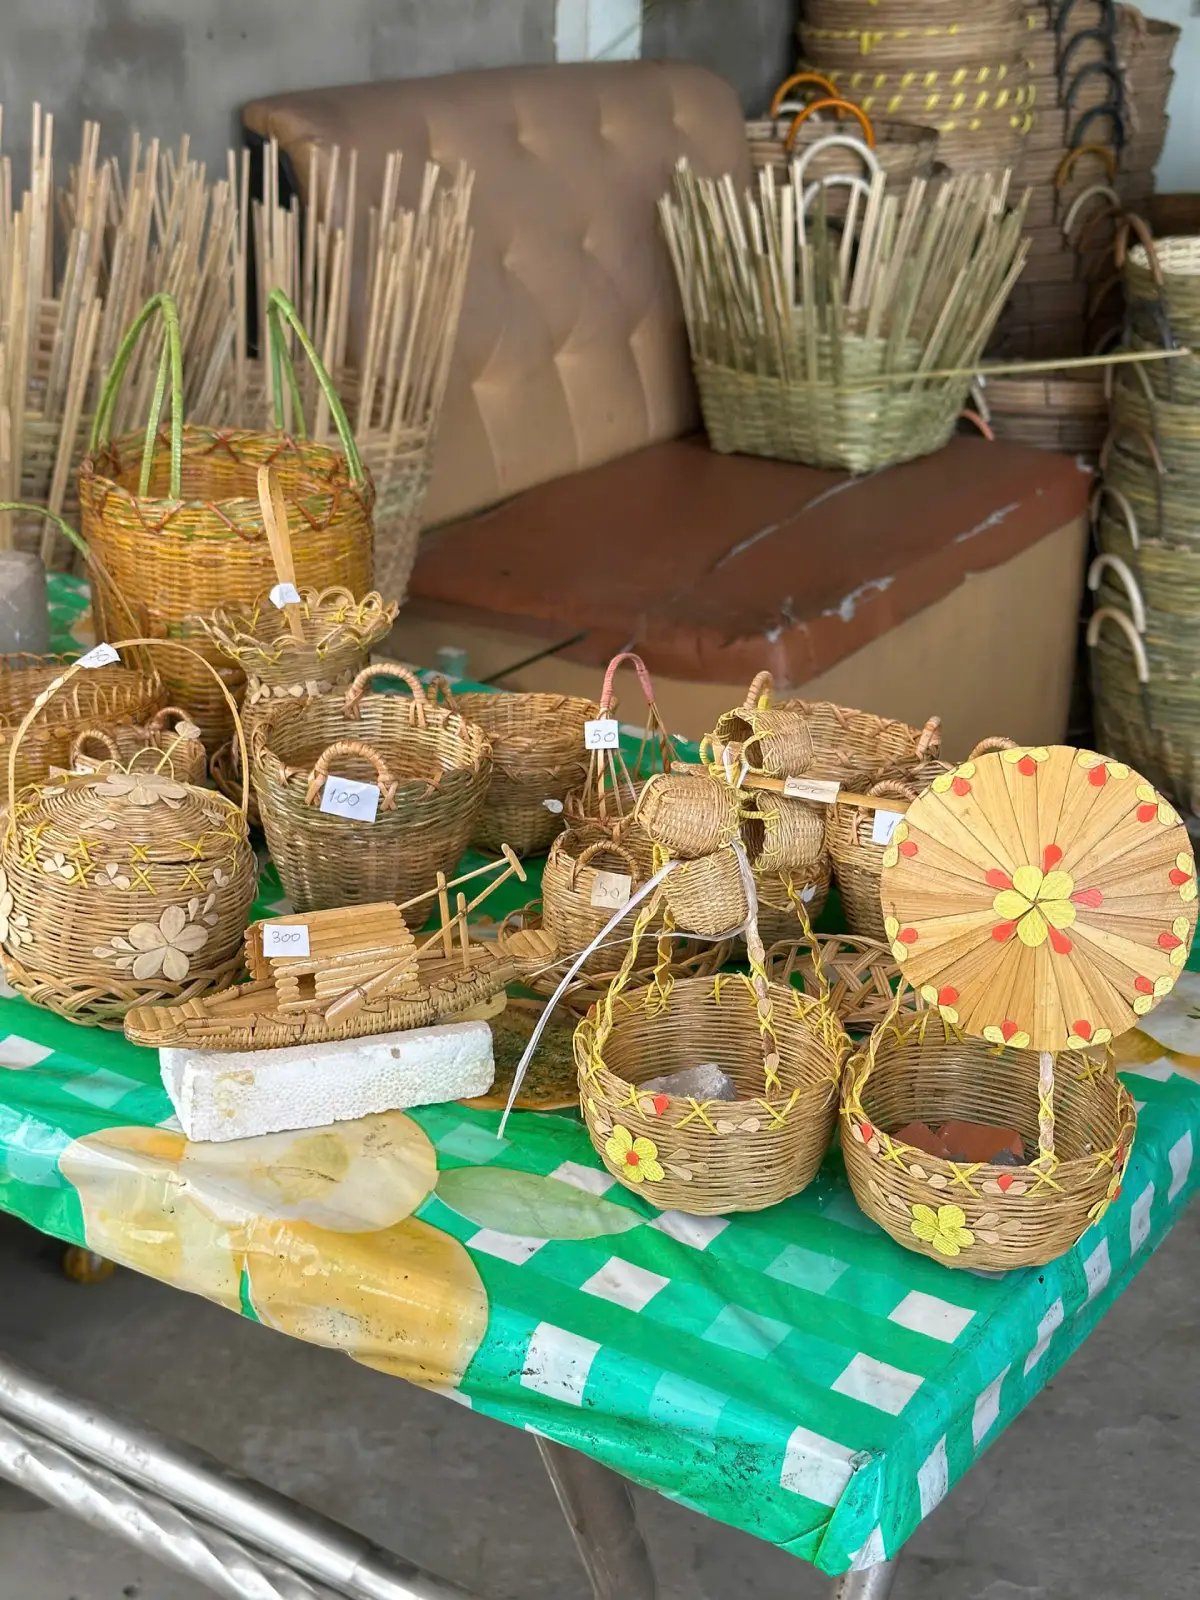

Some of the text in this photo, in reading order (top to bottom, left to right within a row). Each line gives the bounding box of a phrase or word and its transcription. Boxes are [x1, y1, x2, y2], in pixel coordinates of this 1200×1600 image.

[590, 729, 616, 743] 50
[329, 788, 360, 807] 100
[595, 881, 620, 900] 50
[271, 930, 301, 944] 300
